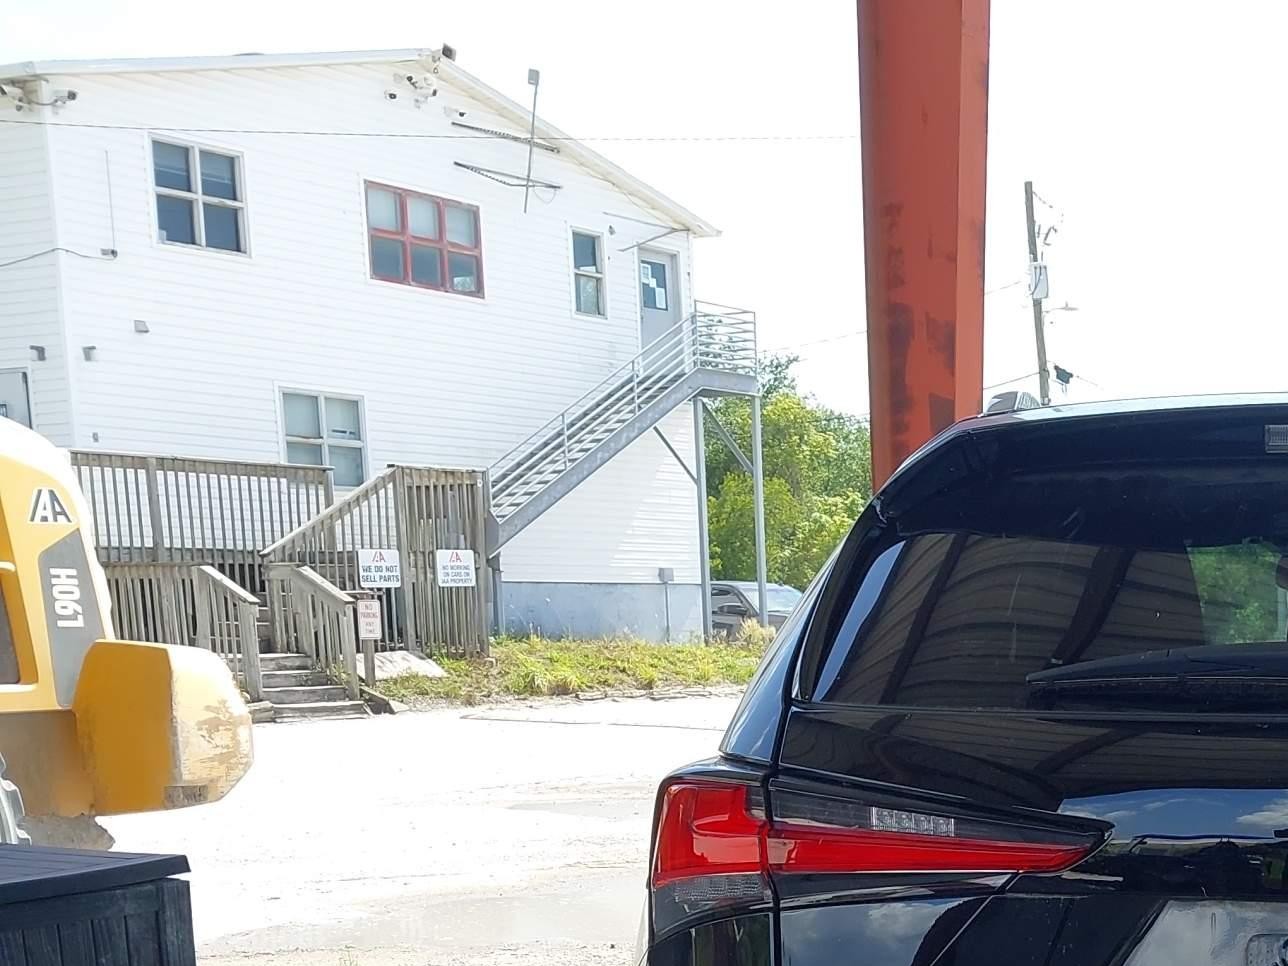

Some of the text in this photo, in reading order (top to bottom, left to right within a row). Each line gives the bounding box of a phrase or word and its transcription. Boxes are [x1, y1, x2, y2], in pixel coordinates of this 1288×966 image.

[361, 565, 398, 573] WE DO NOT
[361, 574, 399, 583] SELL PARTS
[49, 568, 84, 627] L90H
[365, 603, 373, 611] NO
